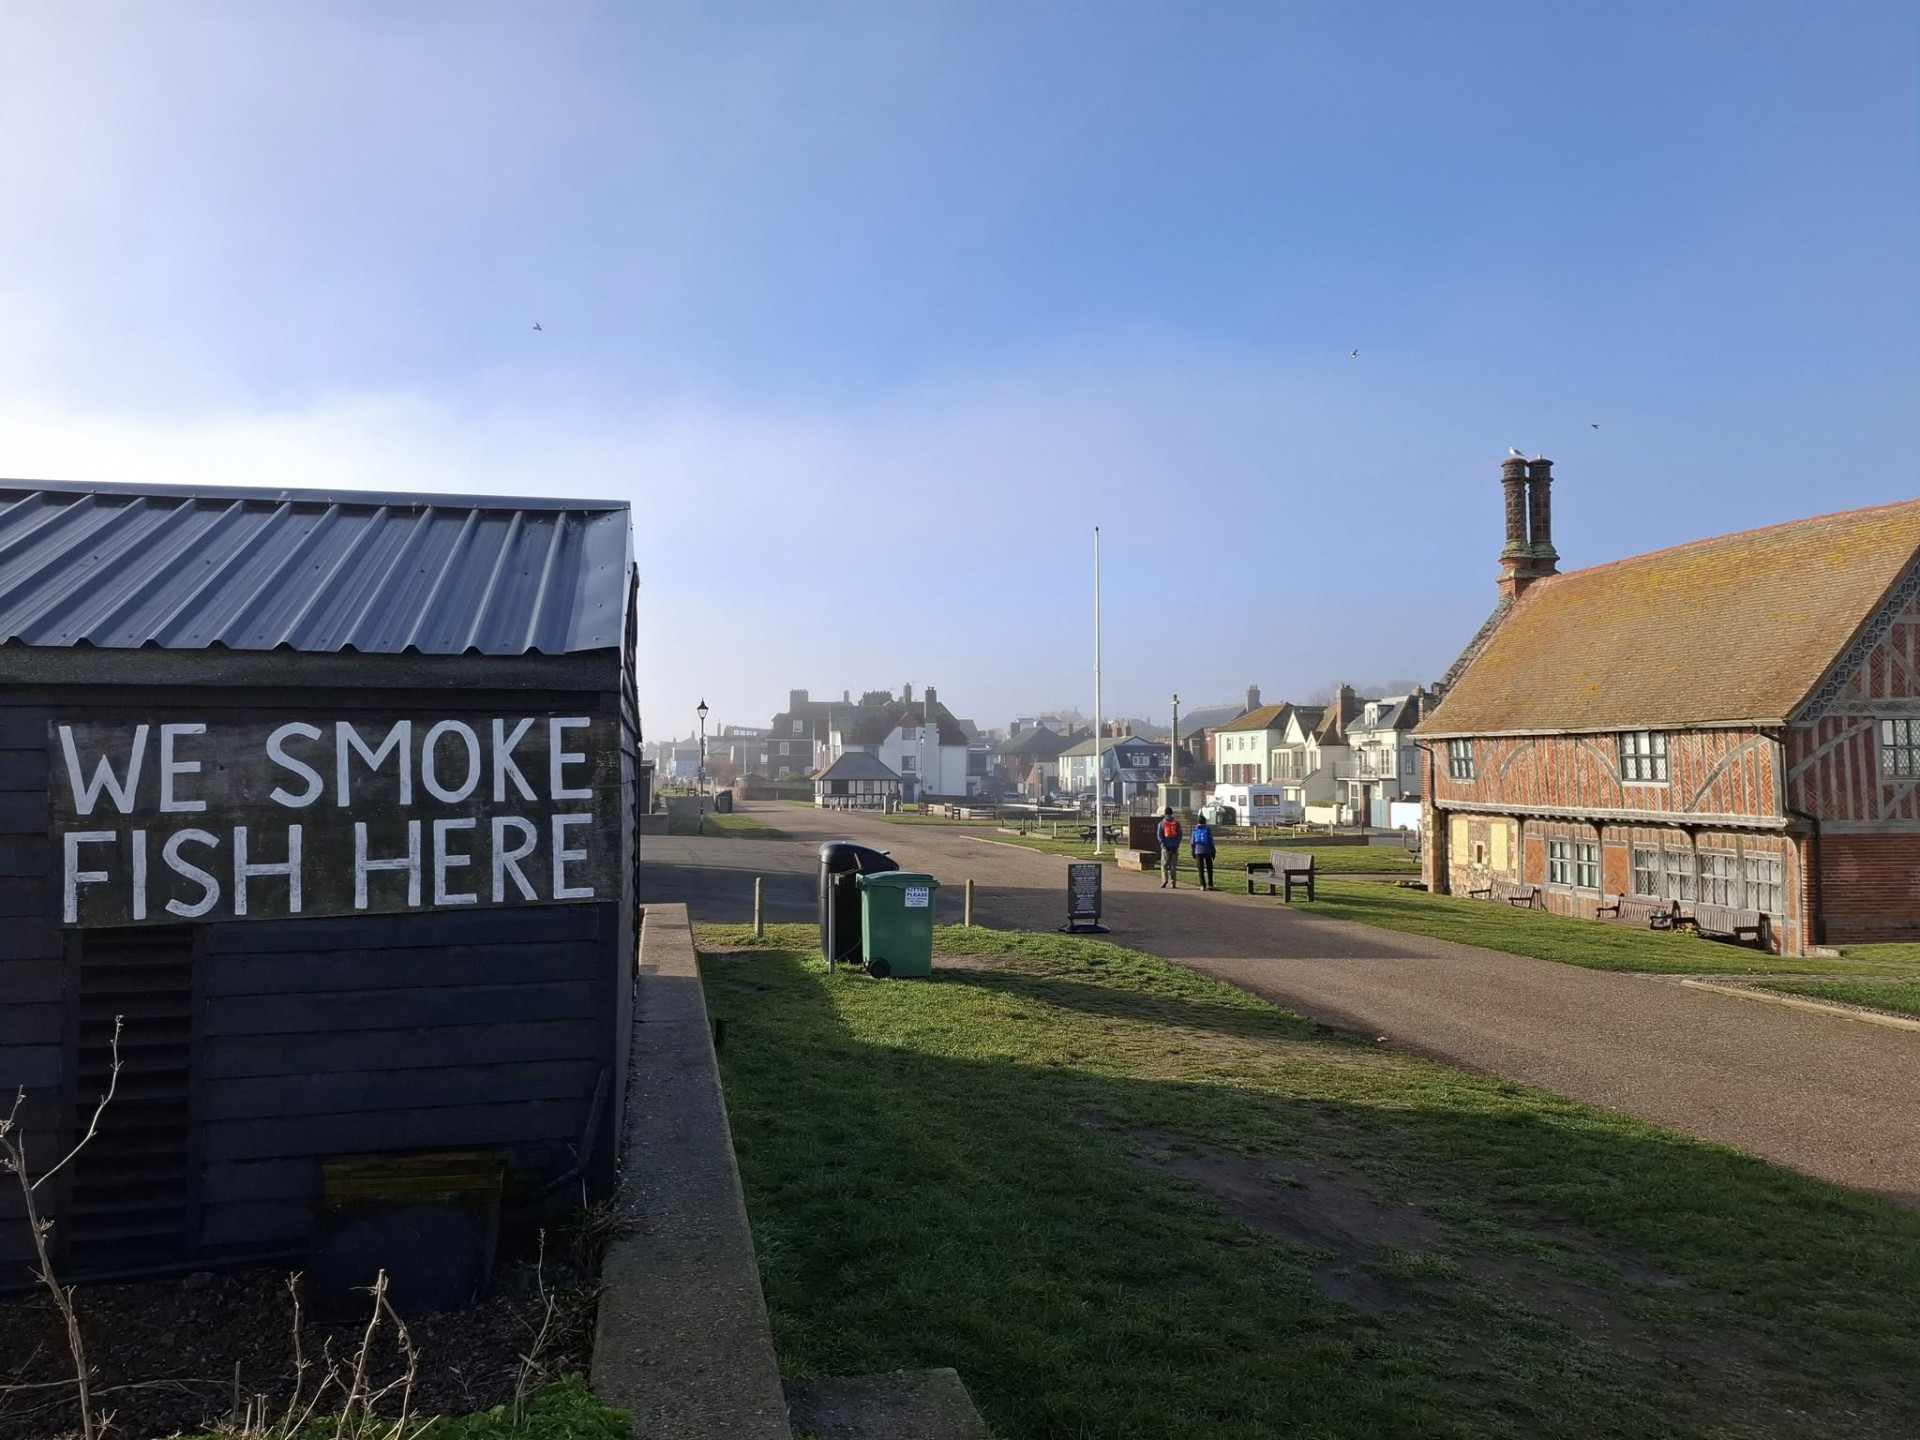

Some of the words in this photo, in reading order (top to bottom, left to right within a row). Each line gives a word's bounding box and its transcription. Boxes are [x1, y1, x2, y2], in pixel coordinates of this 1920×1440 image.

[59, 723, 207, 815] WE
[266, 716, 594, 808] SMOKE
[63, 823, 302, 924] FISH
[354, 813, 595, 910] HERE
